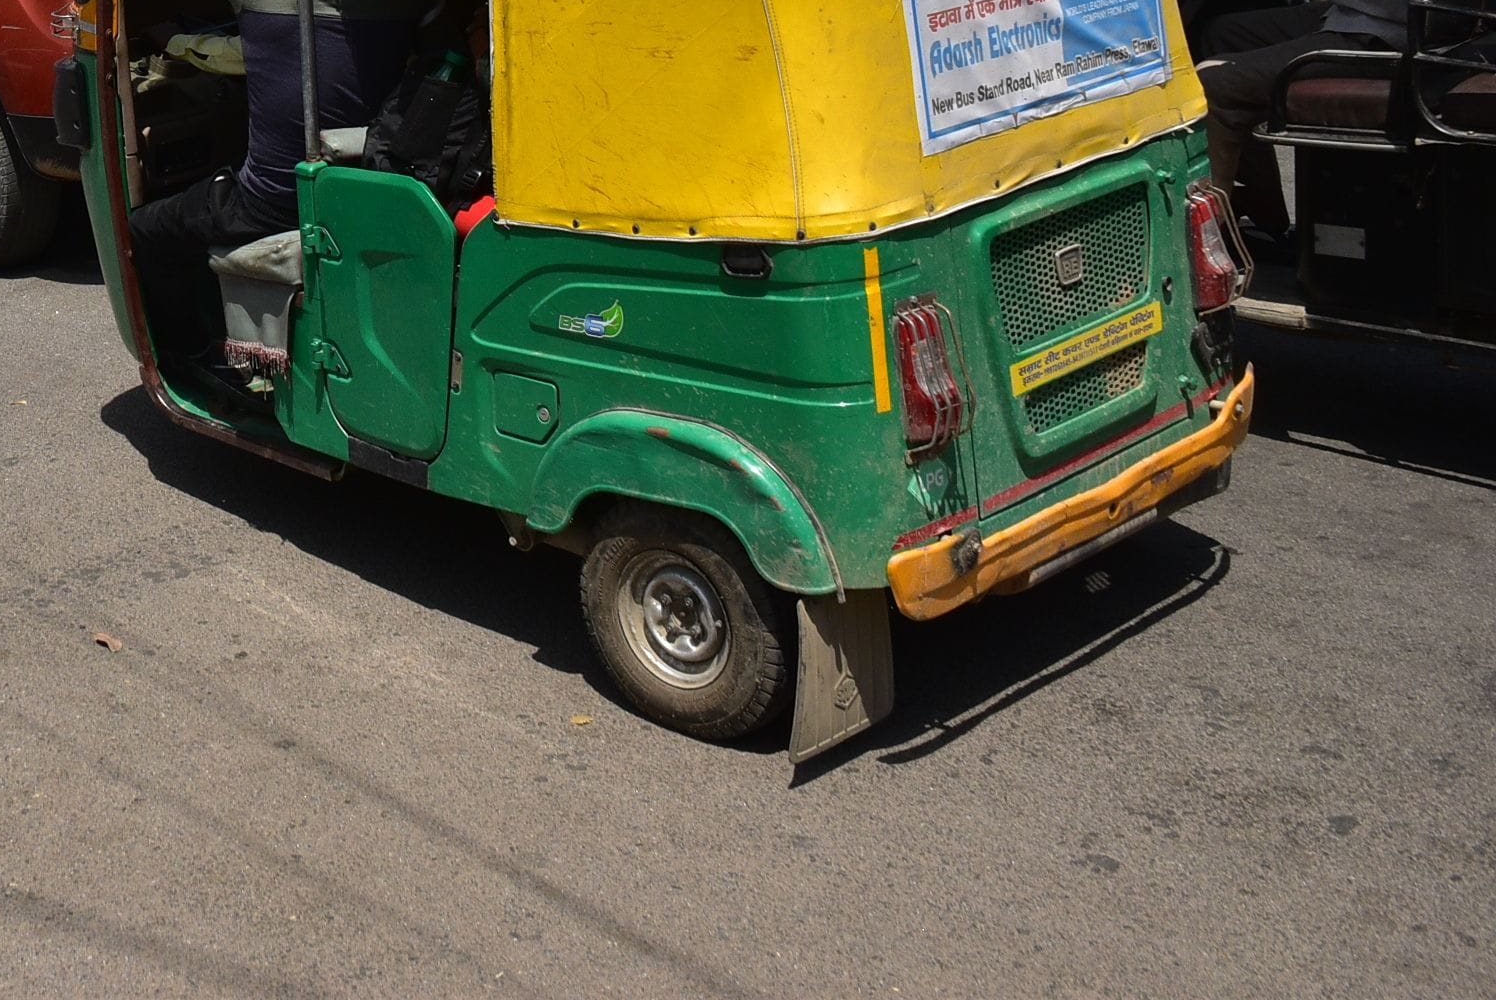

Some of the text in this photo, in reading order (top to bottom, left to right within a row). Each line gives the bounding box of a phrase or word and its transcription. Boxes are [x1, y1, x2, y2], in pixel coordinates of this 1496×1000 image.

[927, 7, 962, 32] इटावा
[930, 12, 1061, 78] Adarsh Electronics
[932, 97, 954, 116] New
[955, 91, 975, 108] Bus
[977, 79, 1004, 102] Stand
[1006, 72, 1034, 94] Road,
[1034, 67, 1053, 87] Near
[1055, 61, 1075, 79] Ram
[1076, 51, 1103, 72] Rahim
[1105, 46, 1131, 64] Press,
[559, 313, 605, 338] BS6
[1044, 348, 1061, 366] सीट
[925, 468, 945, 491] PG
